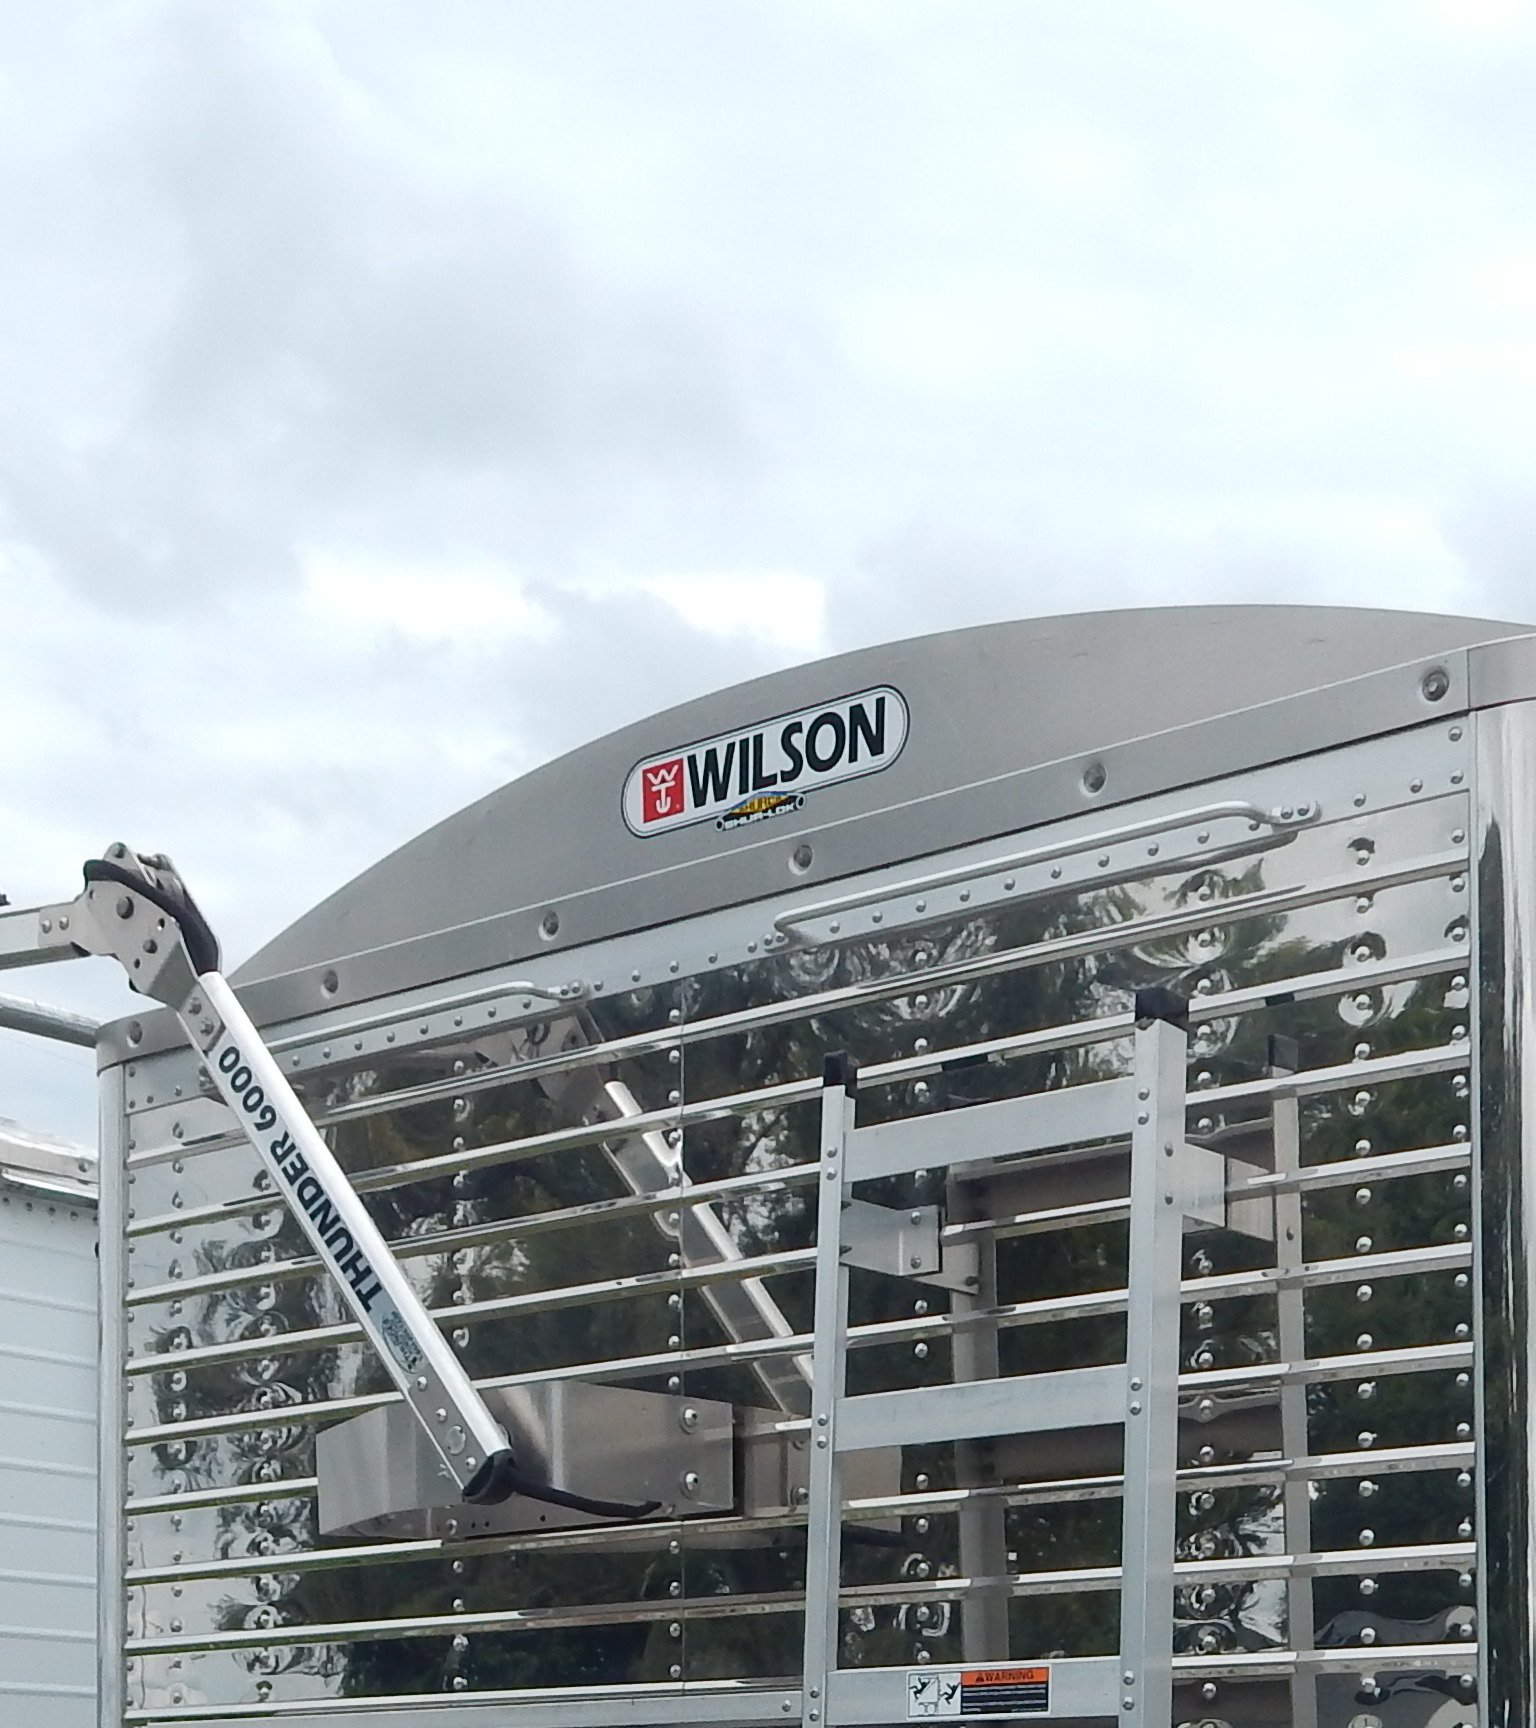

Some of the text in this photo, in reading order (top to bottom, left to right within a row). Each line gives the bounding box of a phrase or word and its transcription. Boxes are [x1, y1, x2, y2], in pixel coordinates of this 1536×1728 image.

[687, 697, 885, 808] WILSON
[219, 1046, 382, 1312] THUNDER 6000
[985, 1670, 1034, 1682] WARNING
